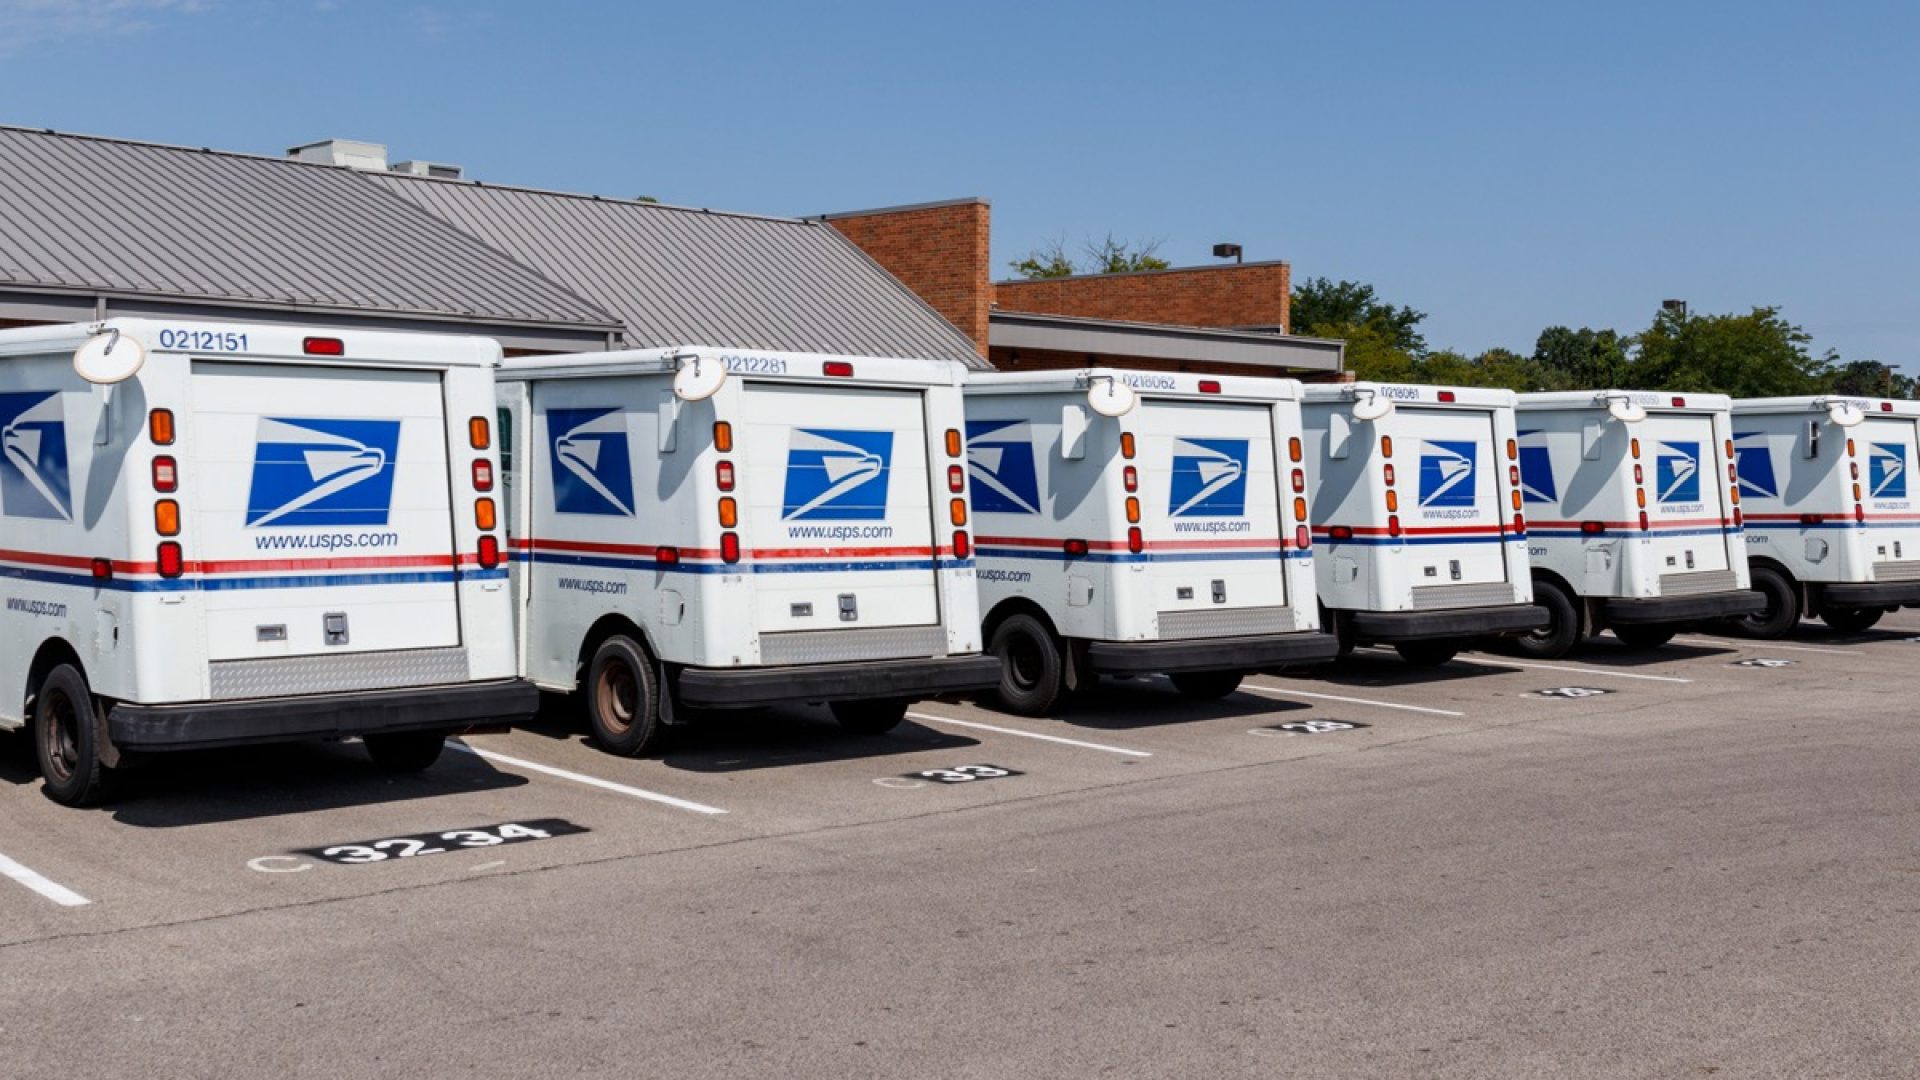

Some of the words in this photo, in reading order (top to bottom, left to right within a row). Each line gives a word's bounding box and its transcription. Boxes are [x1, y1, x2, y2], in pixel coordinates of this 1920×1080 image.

[160, 328, 248, 352] 0212151
[721, 354, 787, 374] 0212281
[1422, 508, 1480, 521] www.usps.com
[788, 525, 893, 541] www.usps.com
[1174, 521, 1250, 535] www.usps.com
[255, 532, 398, 552] www.usps.com
[558, 577, 628, 595] www.usps.com
[6, 597, 67, 618] www.usps.com
[921, 765, 1009, 782] 33
